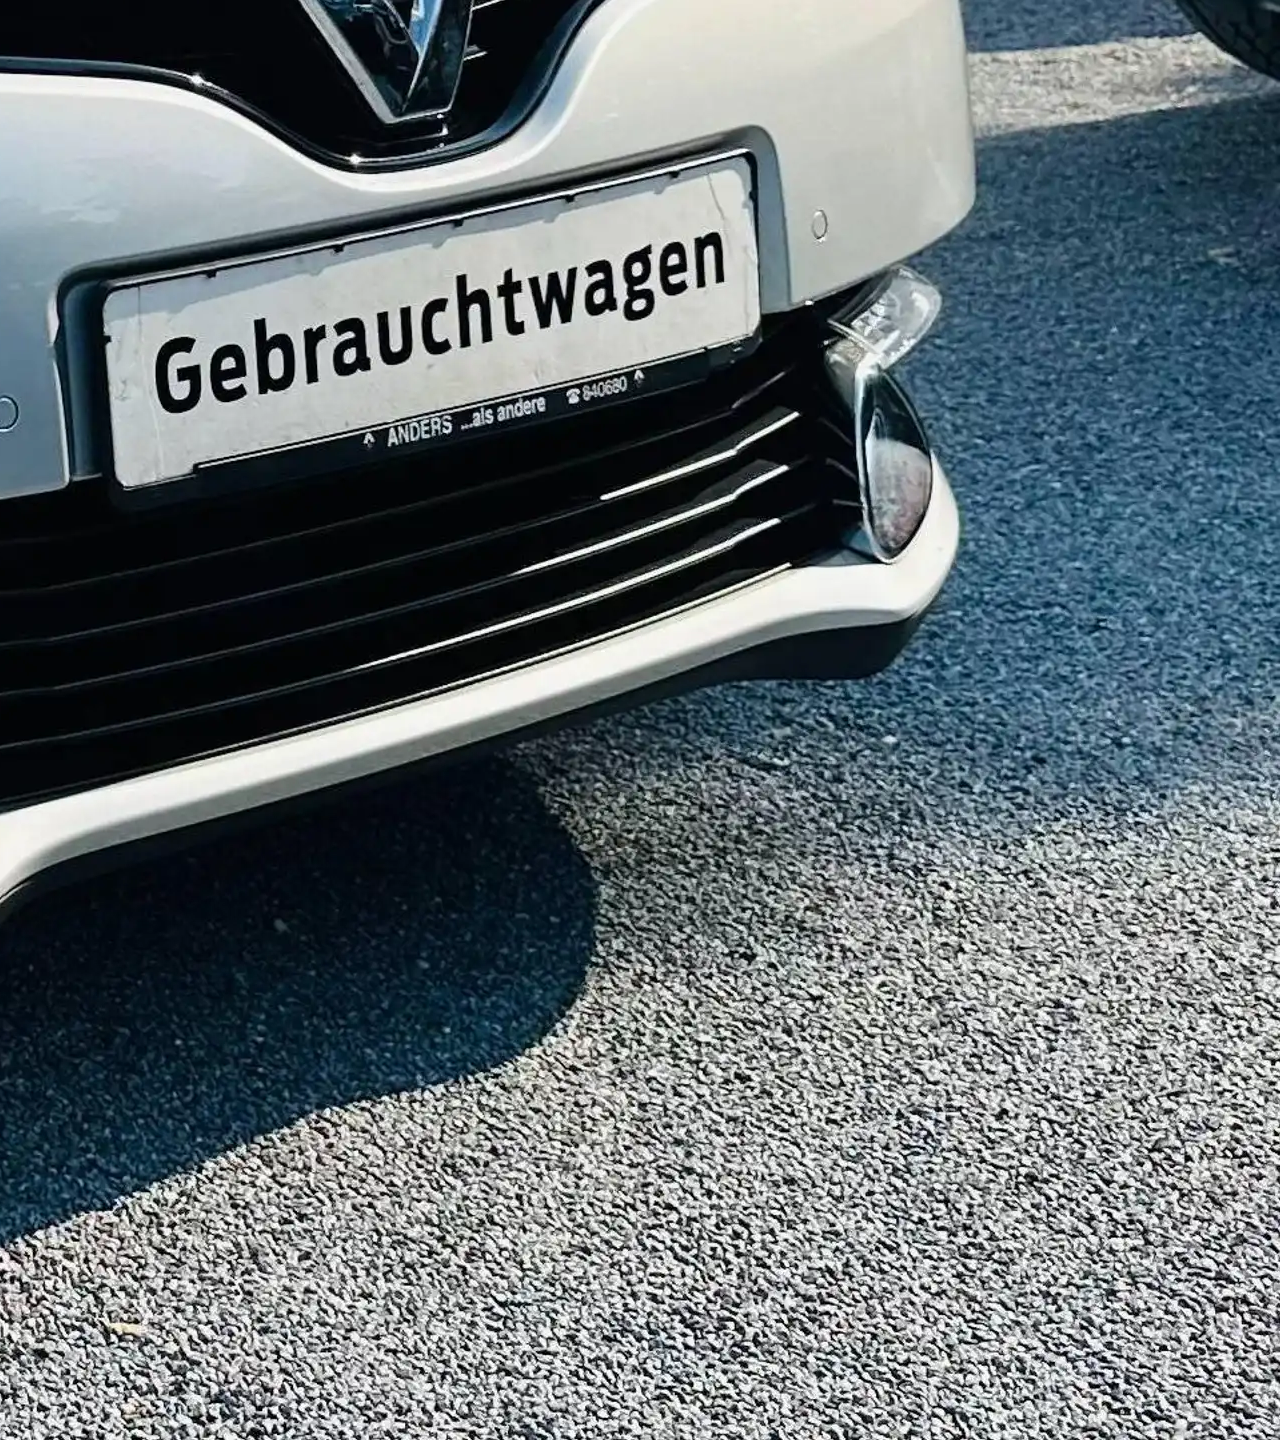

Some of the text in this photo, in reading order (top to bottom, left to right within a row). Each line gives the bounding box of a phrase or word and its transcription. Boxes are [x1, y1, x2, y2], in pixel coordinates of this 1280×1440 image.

[155, 229, 727, 415] Gebrauchtwagen
[387, 415, 453, 447] ANDERS
[497, 395, 547, 422] andere
